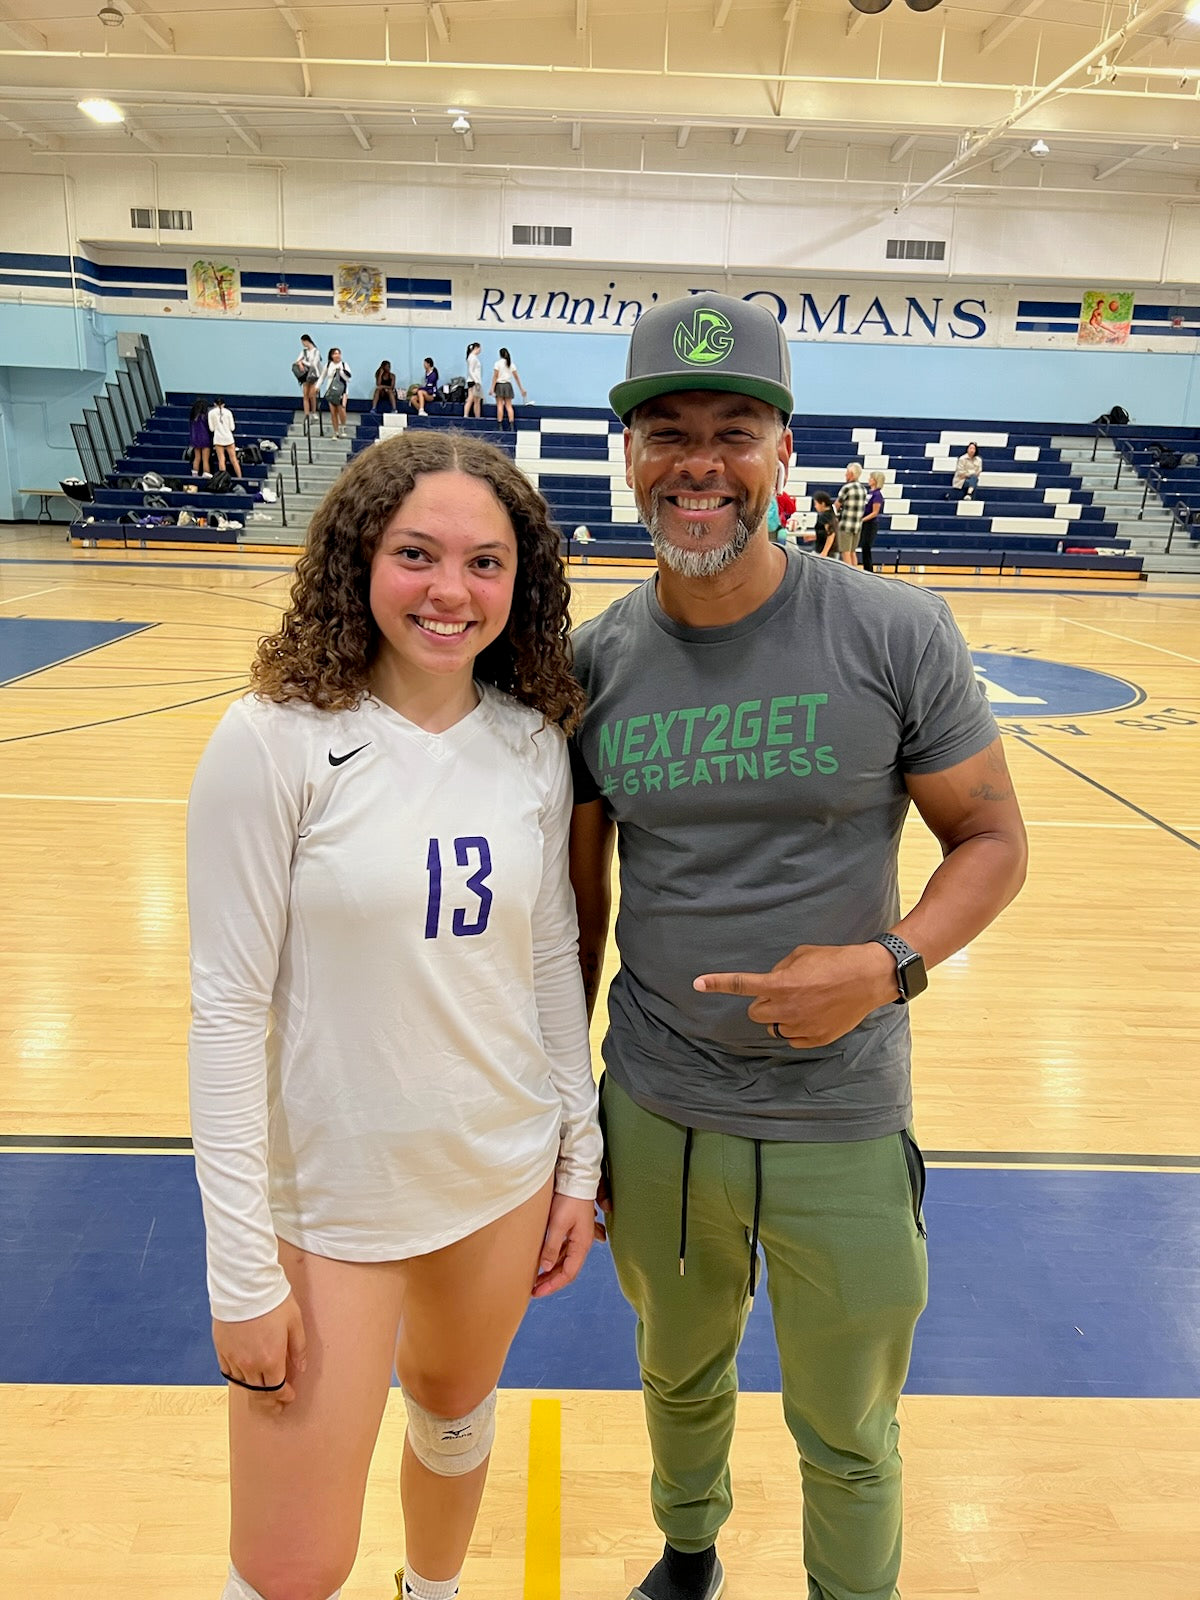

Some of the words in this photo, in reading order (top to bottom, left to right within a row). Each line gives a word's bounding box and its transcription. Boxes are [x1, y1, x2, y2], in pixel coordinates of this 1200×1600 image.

[477, 282, 659, 327] Runnin'
[687, 288, 987, 340] OMANS
[597, 692, 829, 771] NEXT2GET
[601, 745, 840, 796] #GREATNESS
[424, 836, 493, 940] 13
